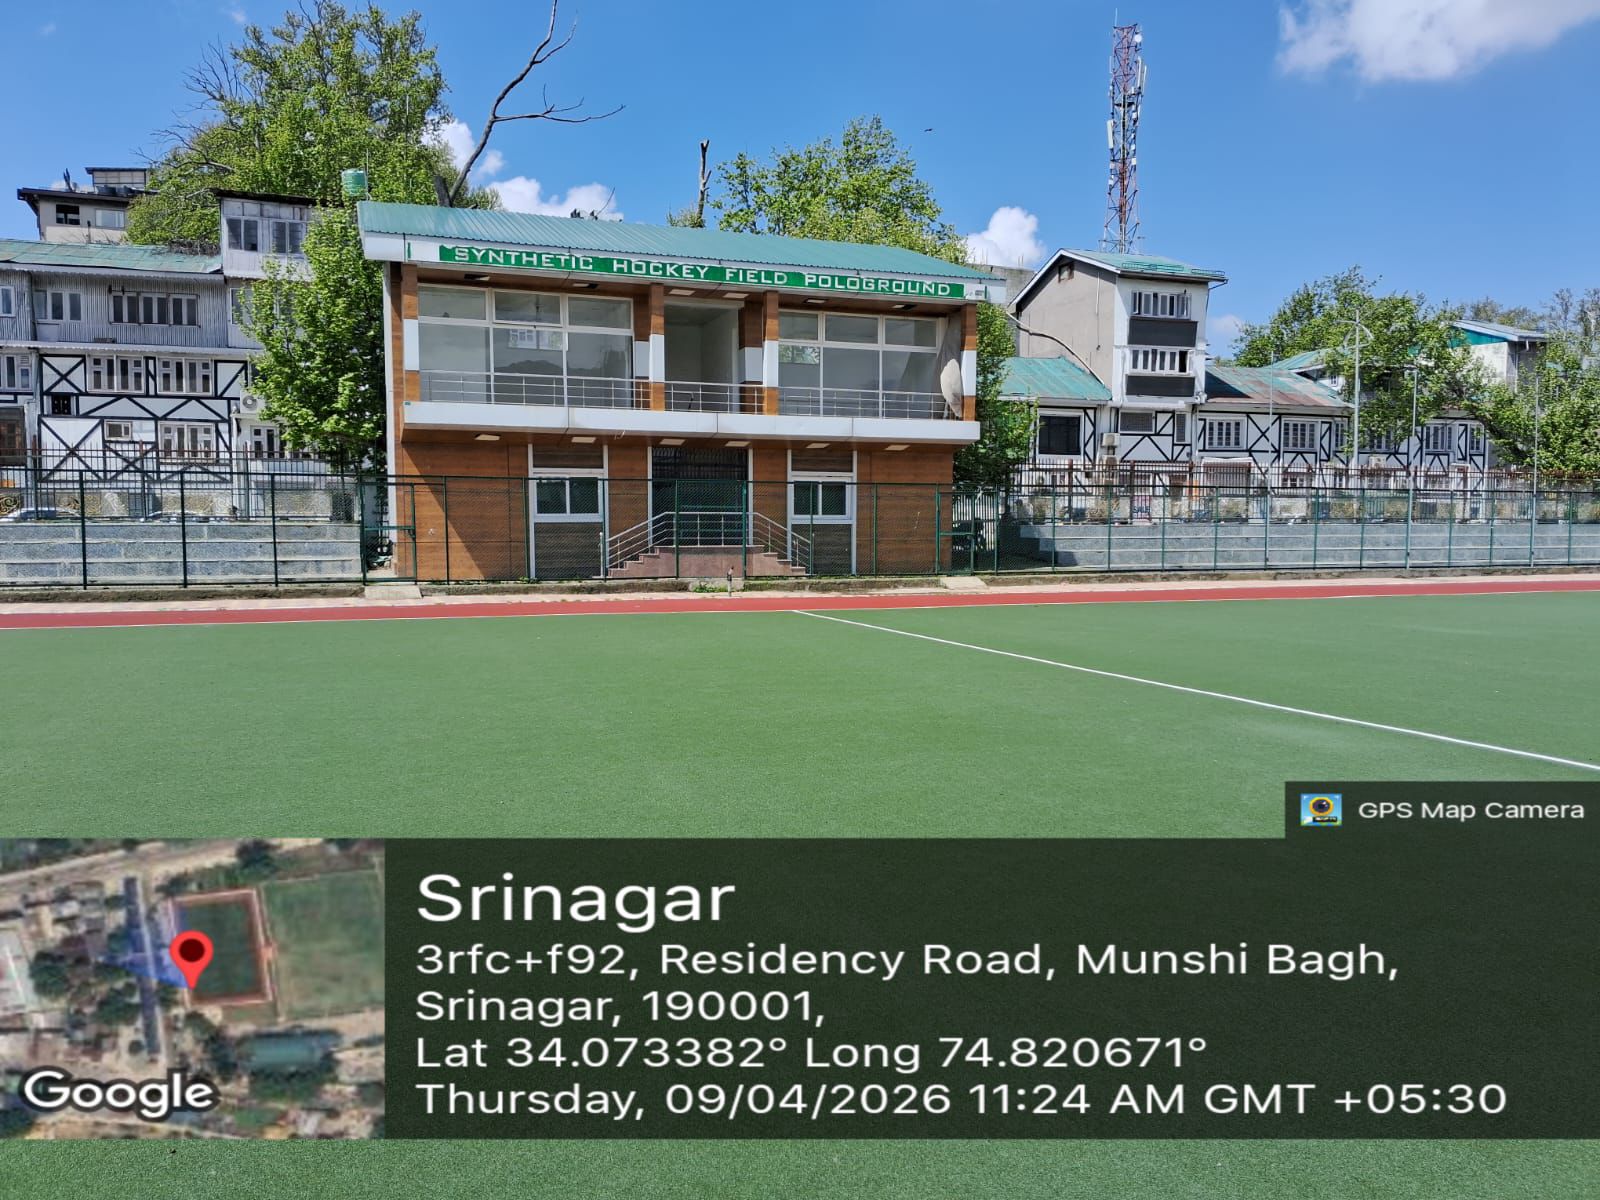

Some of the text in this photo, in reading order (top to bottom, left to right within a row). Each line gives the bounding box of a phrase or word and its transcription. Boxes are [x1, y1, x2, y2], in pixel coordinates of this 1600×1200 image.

[454, 247, 951, 296] SYNTHETIC HOCKEY FIELD POLOGROUND
